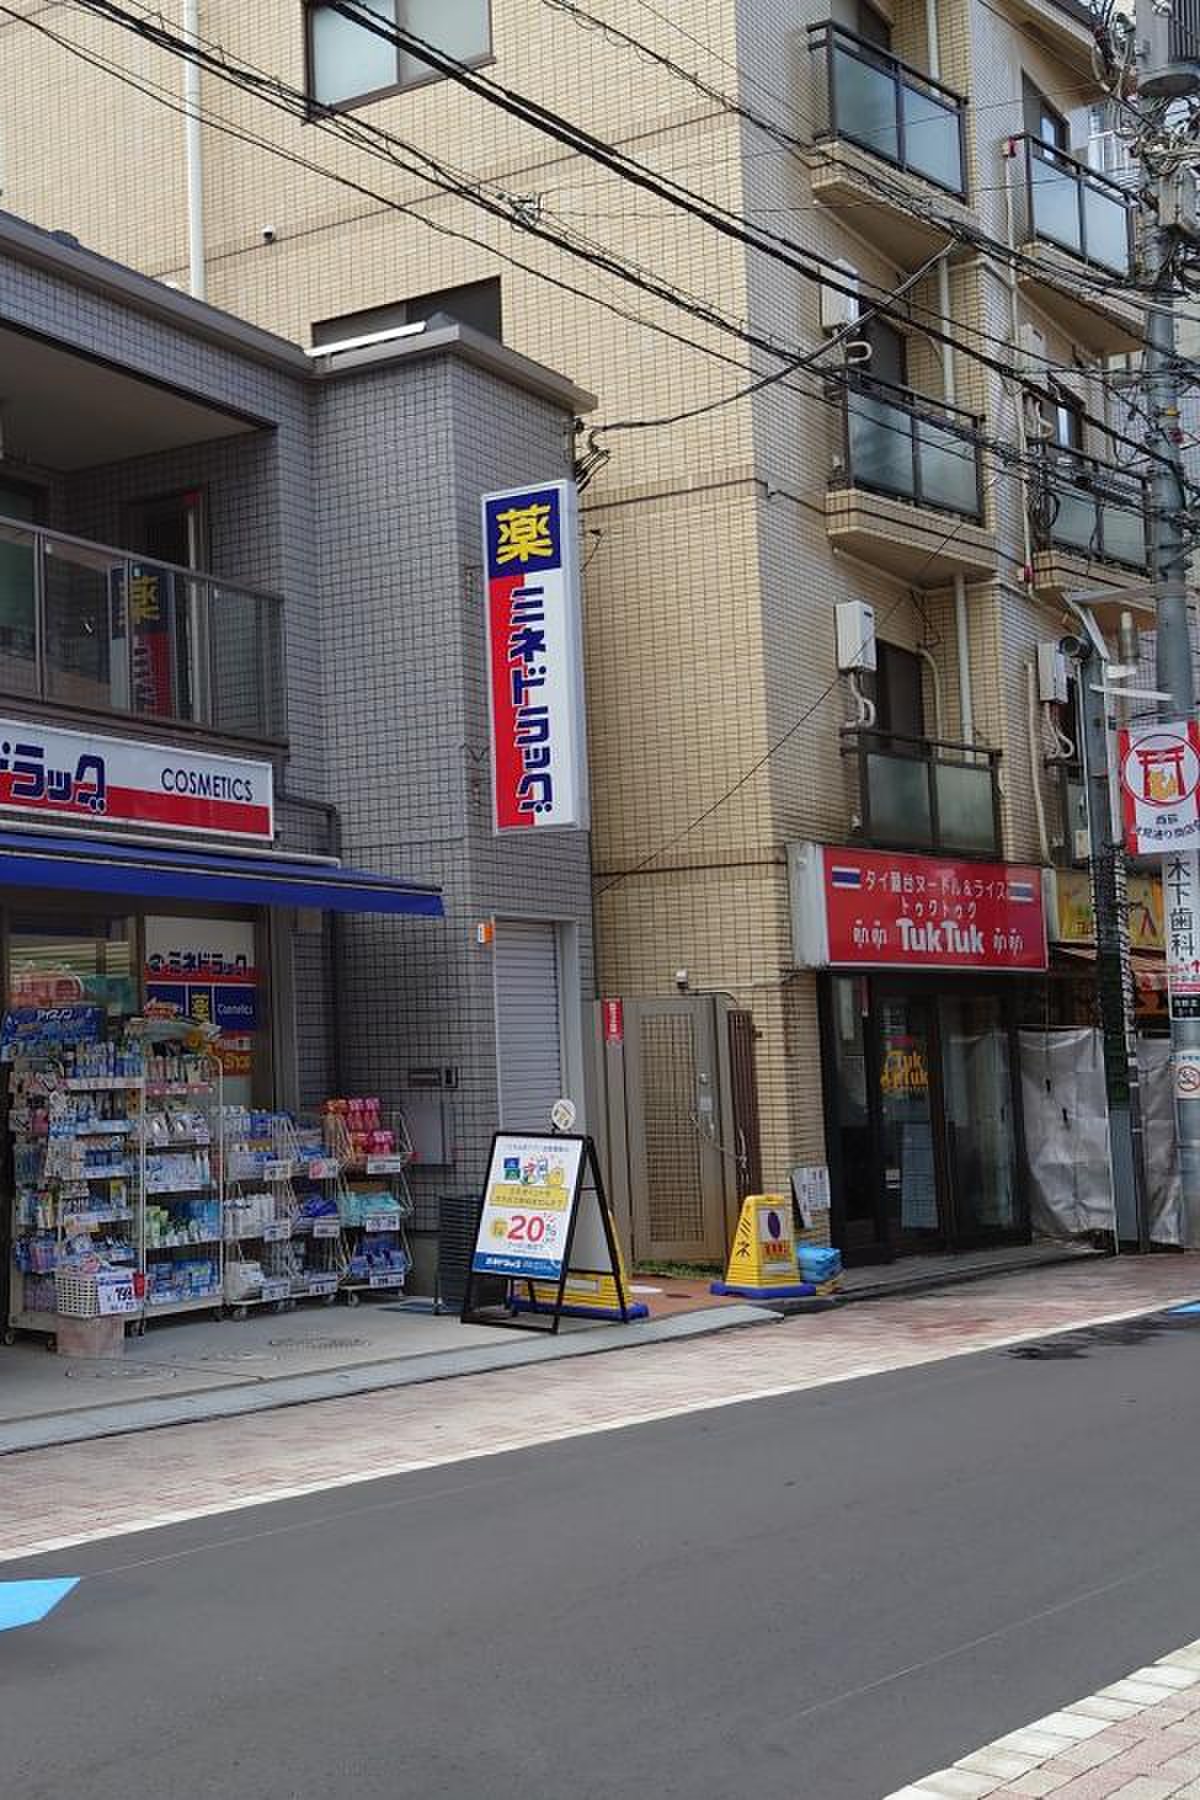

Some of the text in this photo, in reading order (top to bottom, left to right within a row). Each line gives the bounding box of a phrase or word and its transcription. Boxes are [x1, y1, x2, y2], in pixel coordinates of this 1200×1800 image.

[496, 503, 553, 566] 薬
[509, 586, 553, 814] ミネドラッグ
[161, 767, 254, 801] COSMETICS
